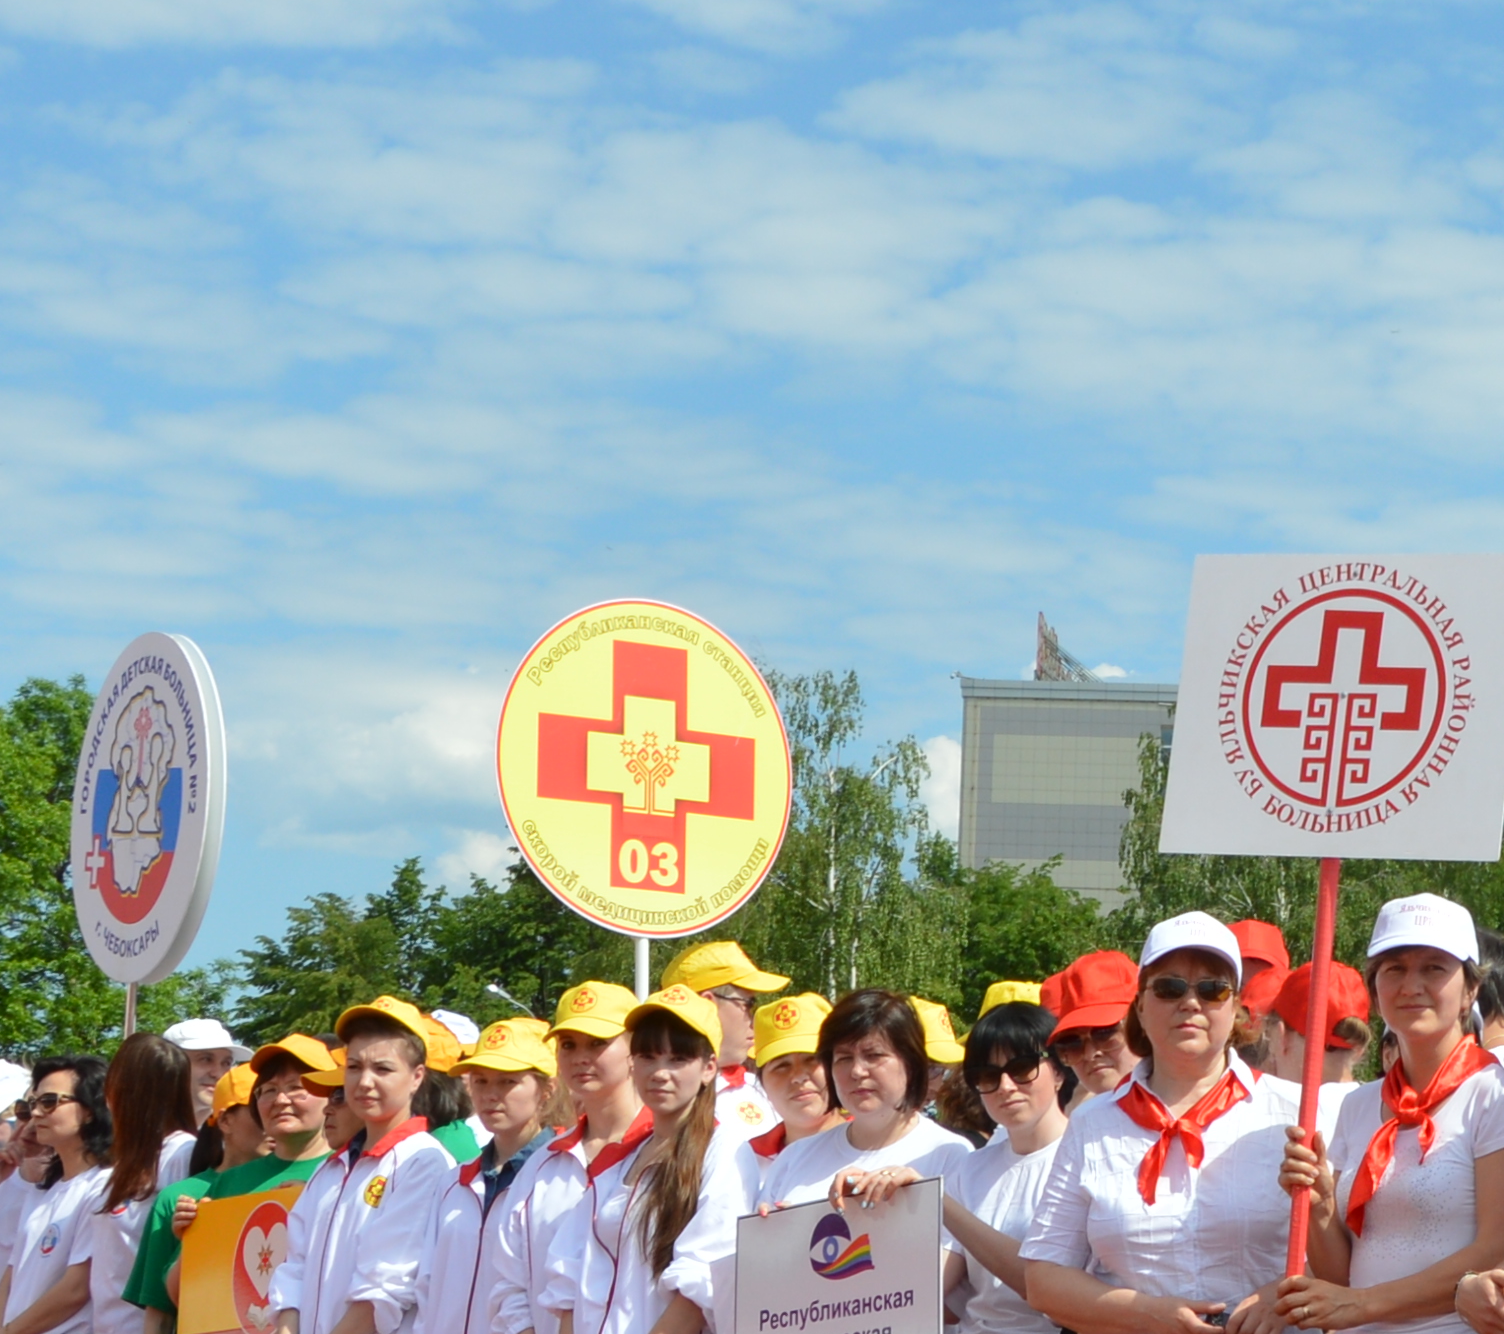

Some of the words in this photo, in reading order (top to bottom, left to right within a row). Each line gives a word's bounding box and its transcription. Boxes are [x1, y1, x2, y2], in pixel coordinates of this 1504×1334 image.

[527, 615, 700, 686] Республиканская
[703, 640, 766, 718] станция
[1218, 587, 1292, 765] ЯЛЬЧИКСКАЯ
[1298, 563, 1464, 652] ЦЕНТРАЛЬНАЯ
[1400, 655, 1476, 806] РАЙОННАЯ
[79, 684, 120, 815] ГОРОДСКАЯ
[120, 654, 164, 696] ДЕТСКАЯ
[163, 661, 198, 769] БОЛЬНИЦА
[1234, 768, 1265, 799] БУ
[1261, 794, 1401, 833] БОЛЬНИЦА
[522, 819, 580, 892] скорой
[578, 885, 709, 926] медицинской
[712, 837, 769, 909] помощи
[618, 838, 679, 887] 03
[102, 919, 161, 959] ЧЕБОКСАРЫ
[759, 1289, 915, 1332] Республиканская
